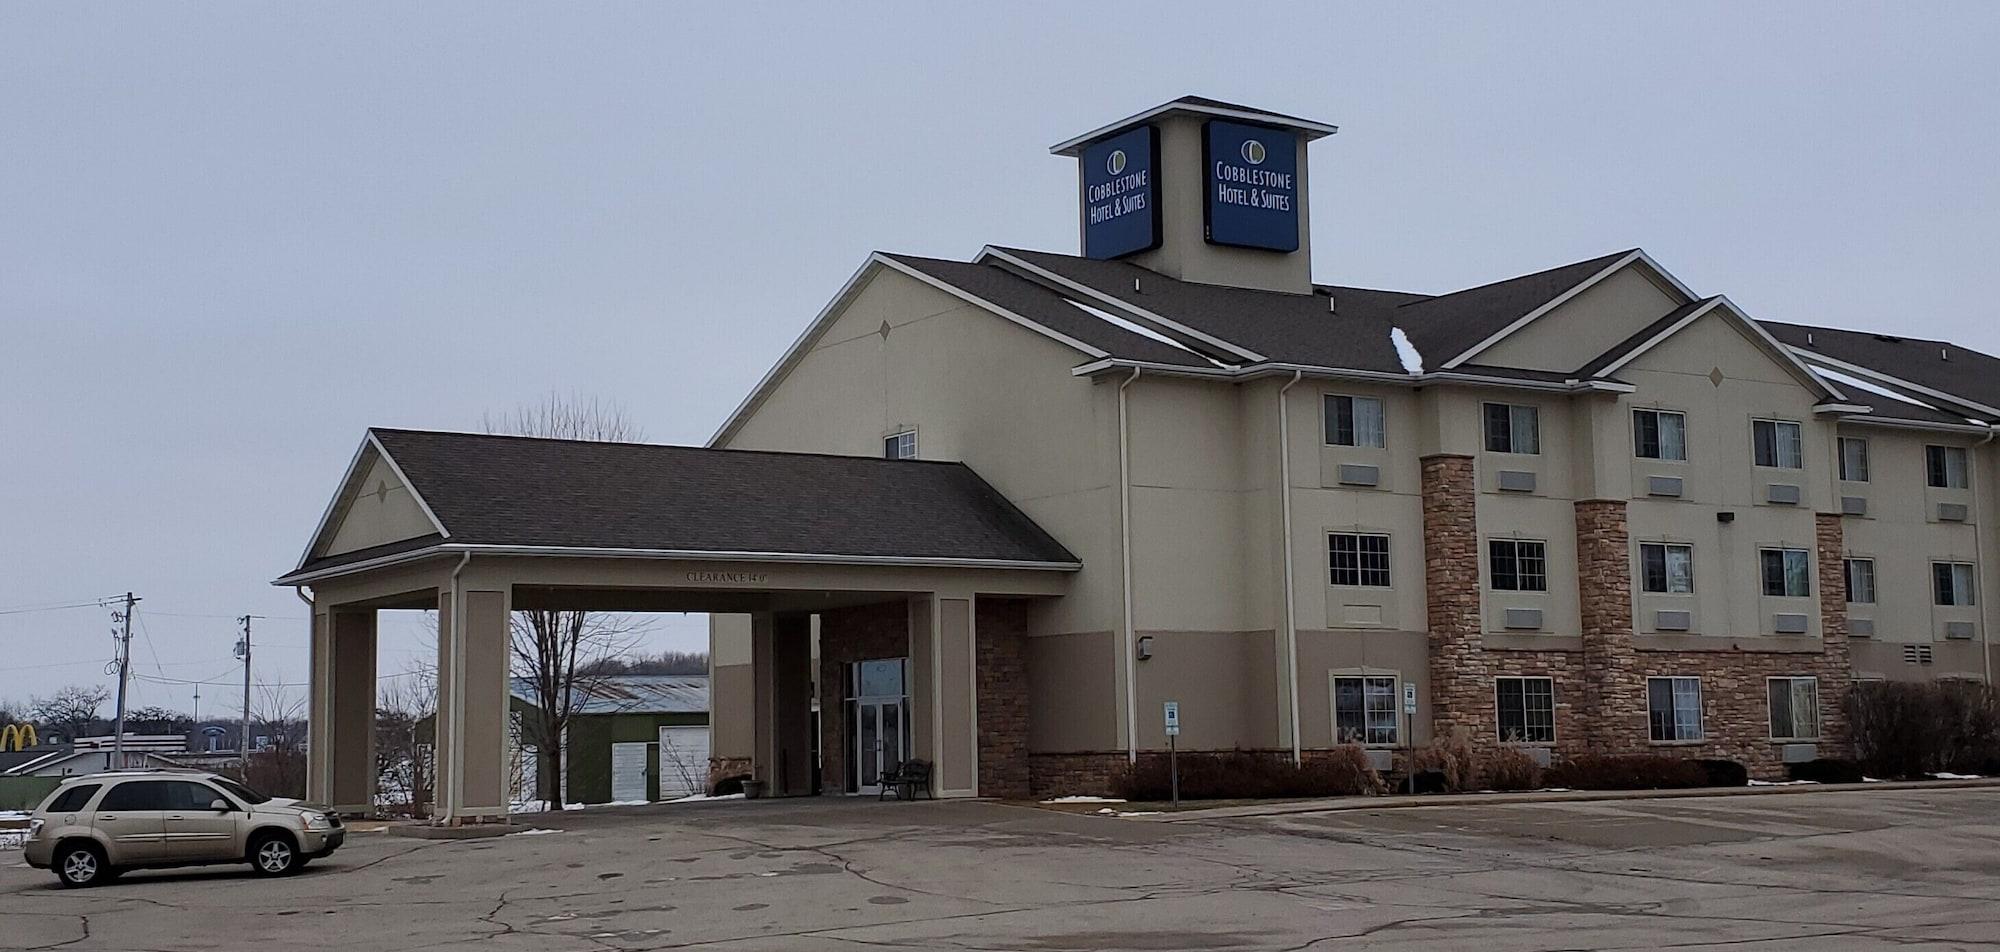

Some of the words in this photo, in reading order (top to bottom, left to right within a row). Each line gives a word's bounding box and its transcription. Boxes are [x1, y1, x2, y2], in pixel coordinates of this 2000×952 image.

[1088, 169, 1147, 204] COBBLESTONE
[1216, 160, 1292, 190] COBBLESTONE
[1090, 202, 1114, 225] HOTEL
[1114, 198, 1122, 217] &
[1122, 192, 1146, 215] SUITES
[1218, 183, 1249, 206] HOTEL
[1250, 188, 1260, 207] &
[1260, 189, 1290, 211] SUITES
[686, 571, 745, 583] CLEARANCE
